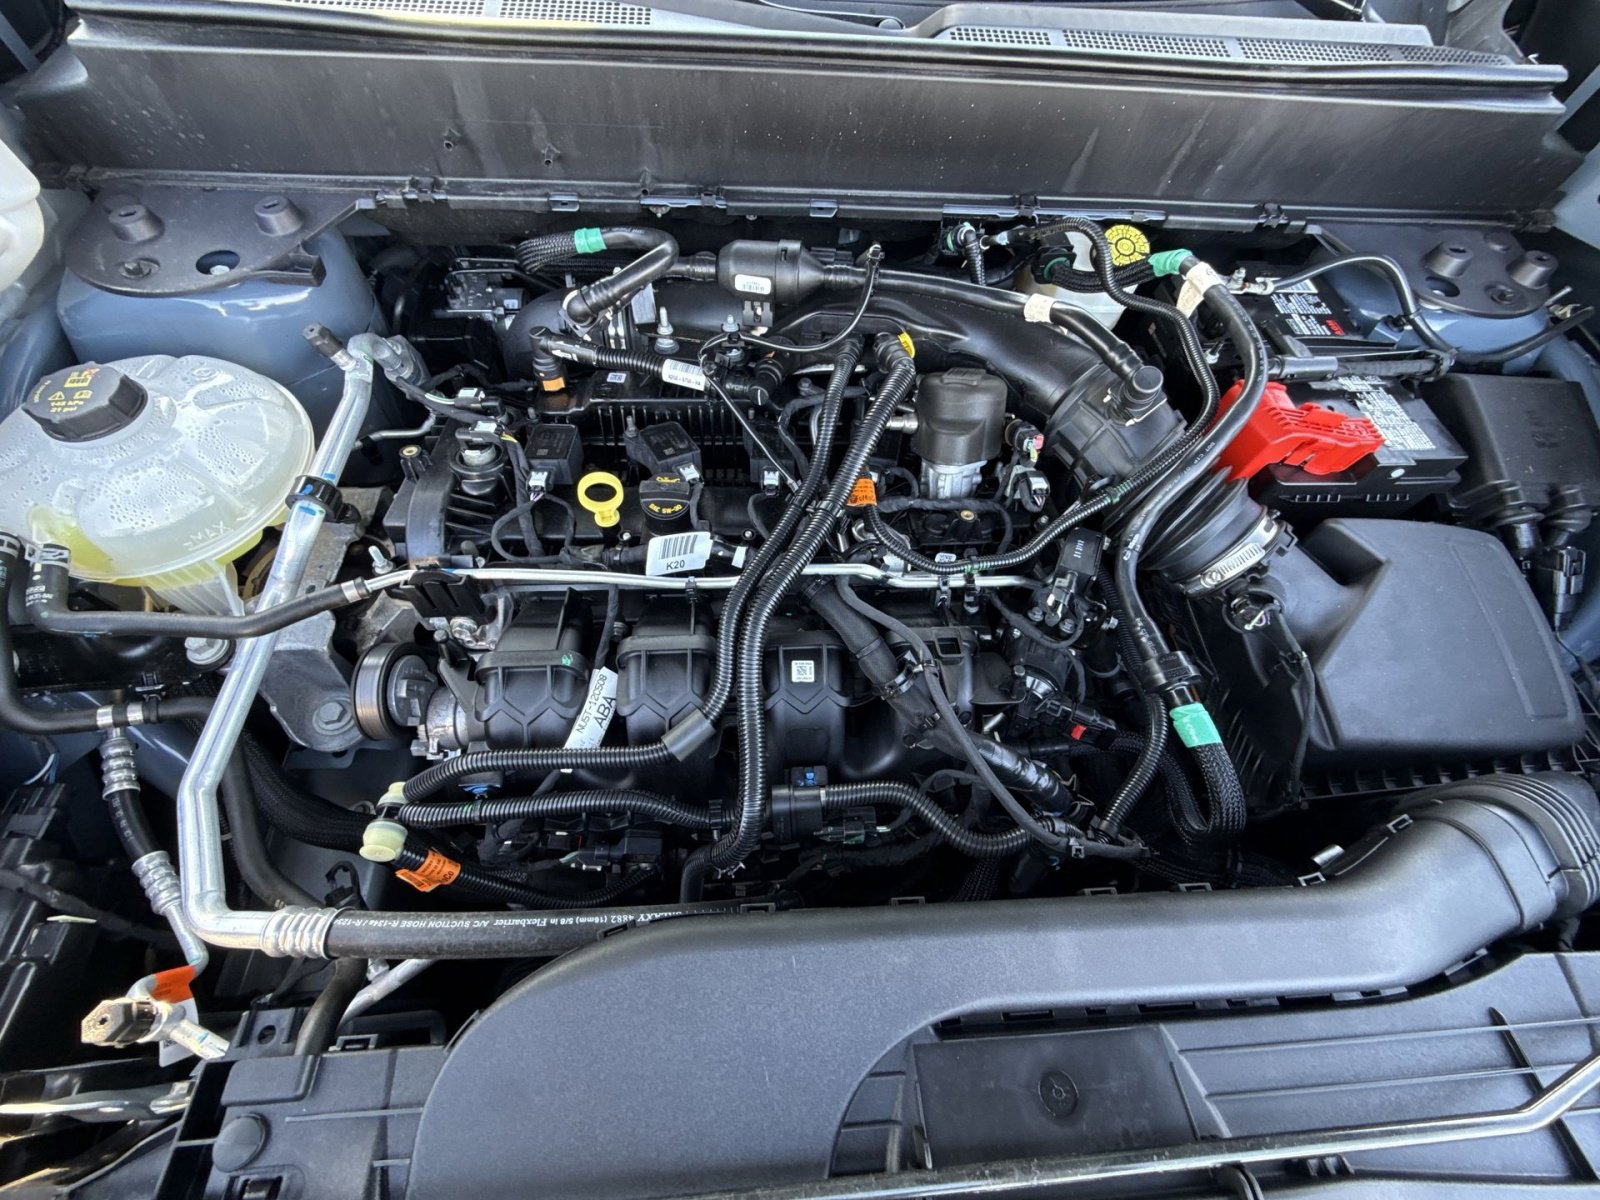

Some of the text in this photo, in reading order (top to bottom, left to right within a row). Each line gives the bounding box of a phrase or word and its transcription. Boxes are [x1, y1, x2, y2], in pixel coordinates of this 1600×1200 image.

[191, 520, 232, 544] MAX
[666, 559, 686, 571] K20
[593, 695, 617, 729] ABA
[493, 917, 547, 928] Flexbarrier
[560, 917, 574, 926] 5/8
[576, 915, 607, 924] (16mm)
[610, 914, 634, 923] 4882
[399, 919, 427, 928] HOSE
[427, 919, 470, 928] SUCTION
[472, 919, 490, 928] A/C
